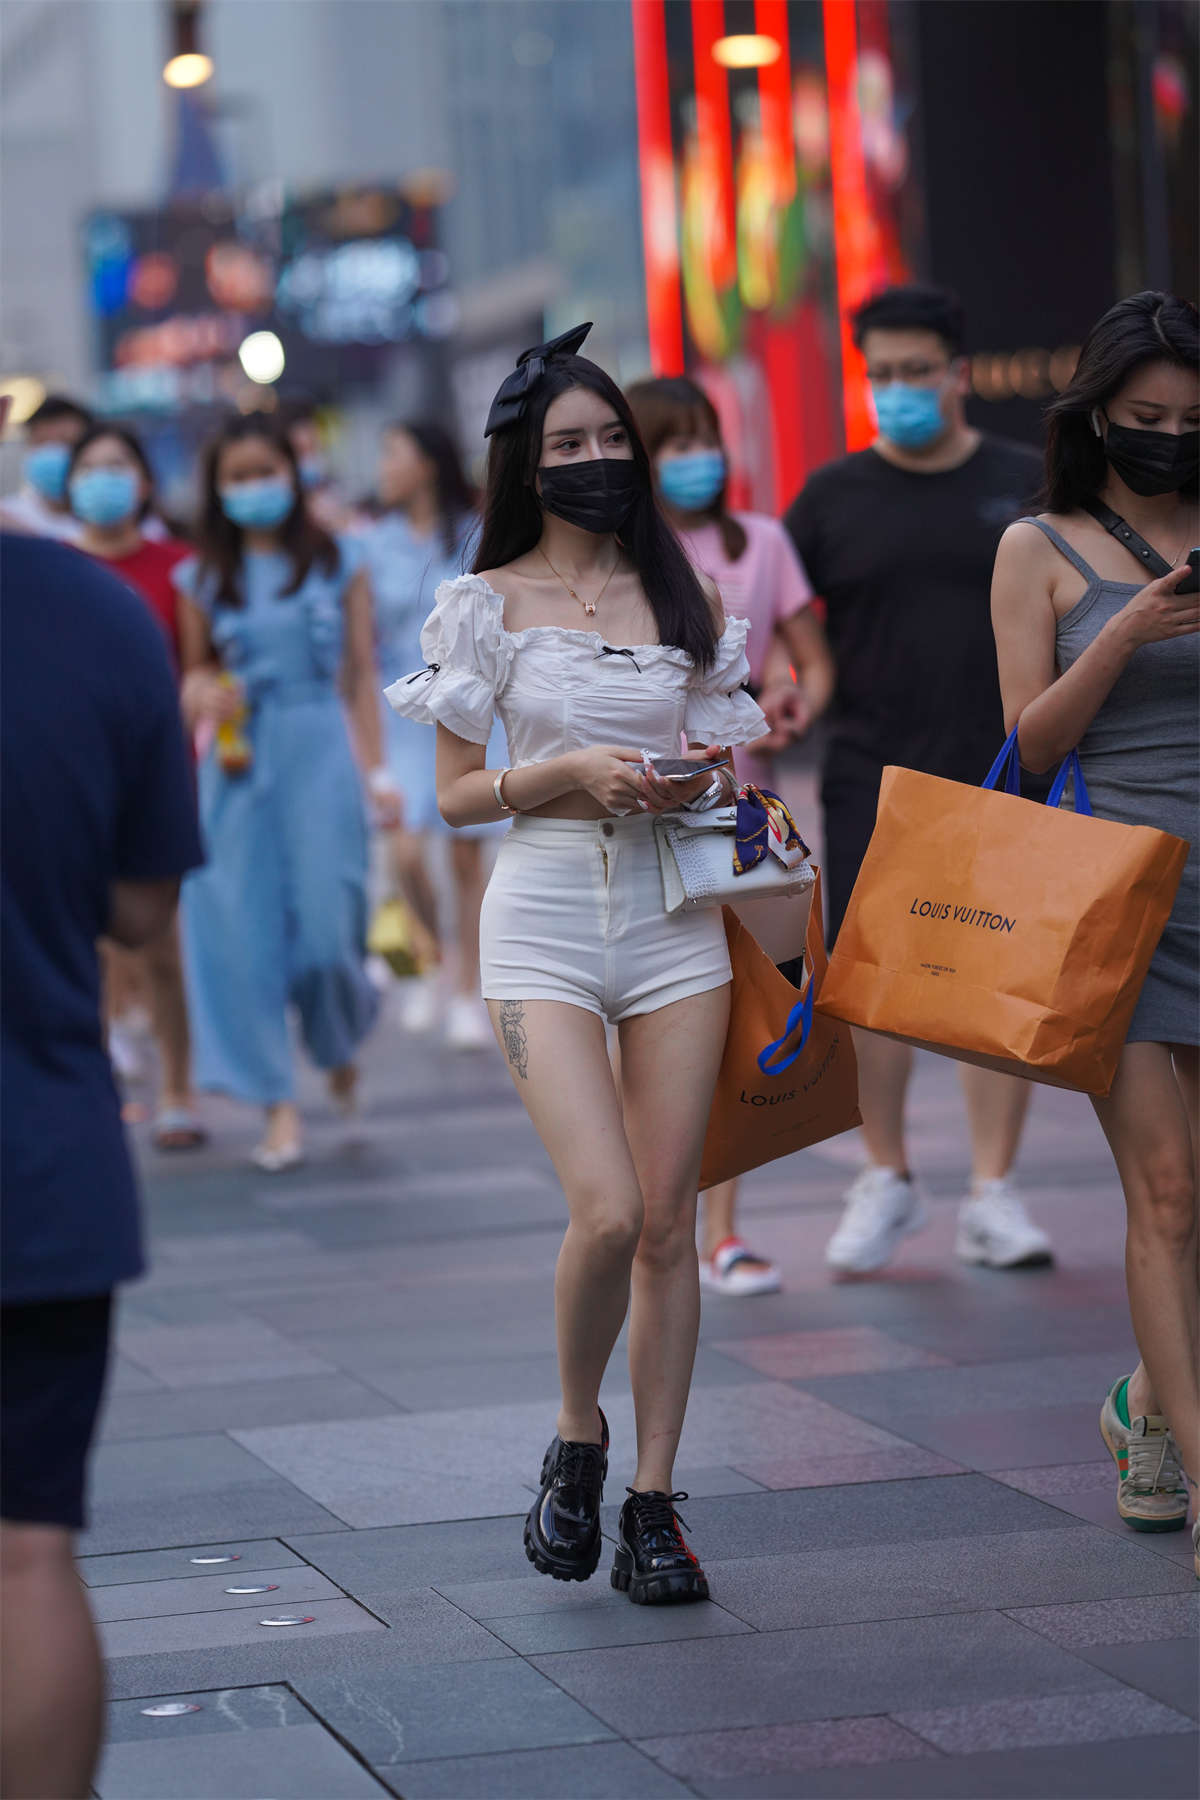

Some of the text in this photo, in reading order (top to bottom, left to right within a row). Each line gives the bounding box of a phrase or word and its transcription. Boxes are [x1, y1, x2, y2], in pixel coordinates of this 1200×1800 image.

[910, 897, 1017, 933] LOUIS VUITTON
[740, 1090, 798, 1106] LOUIS
